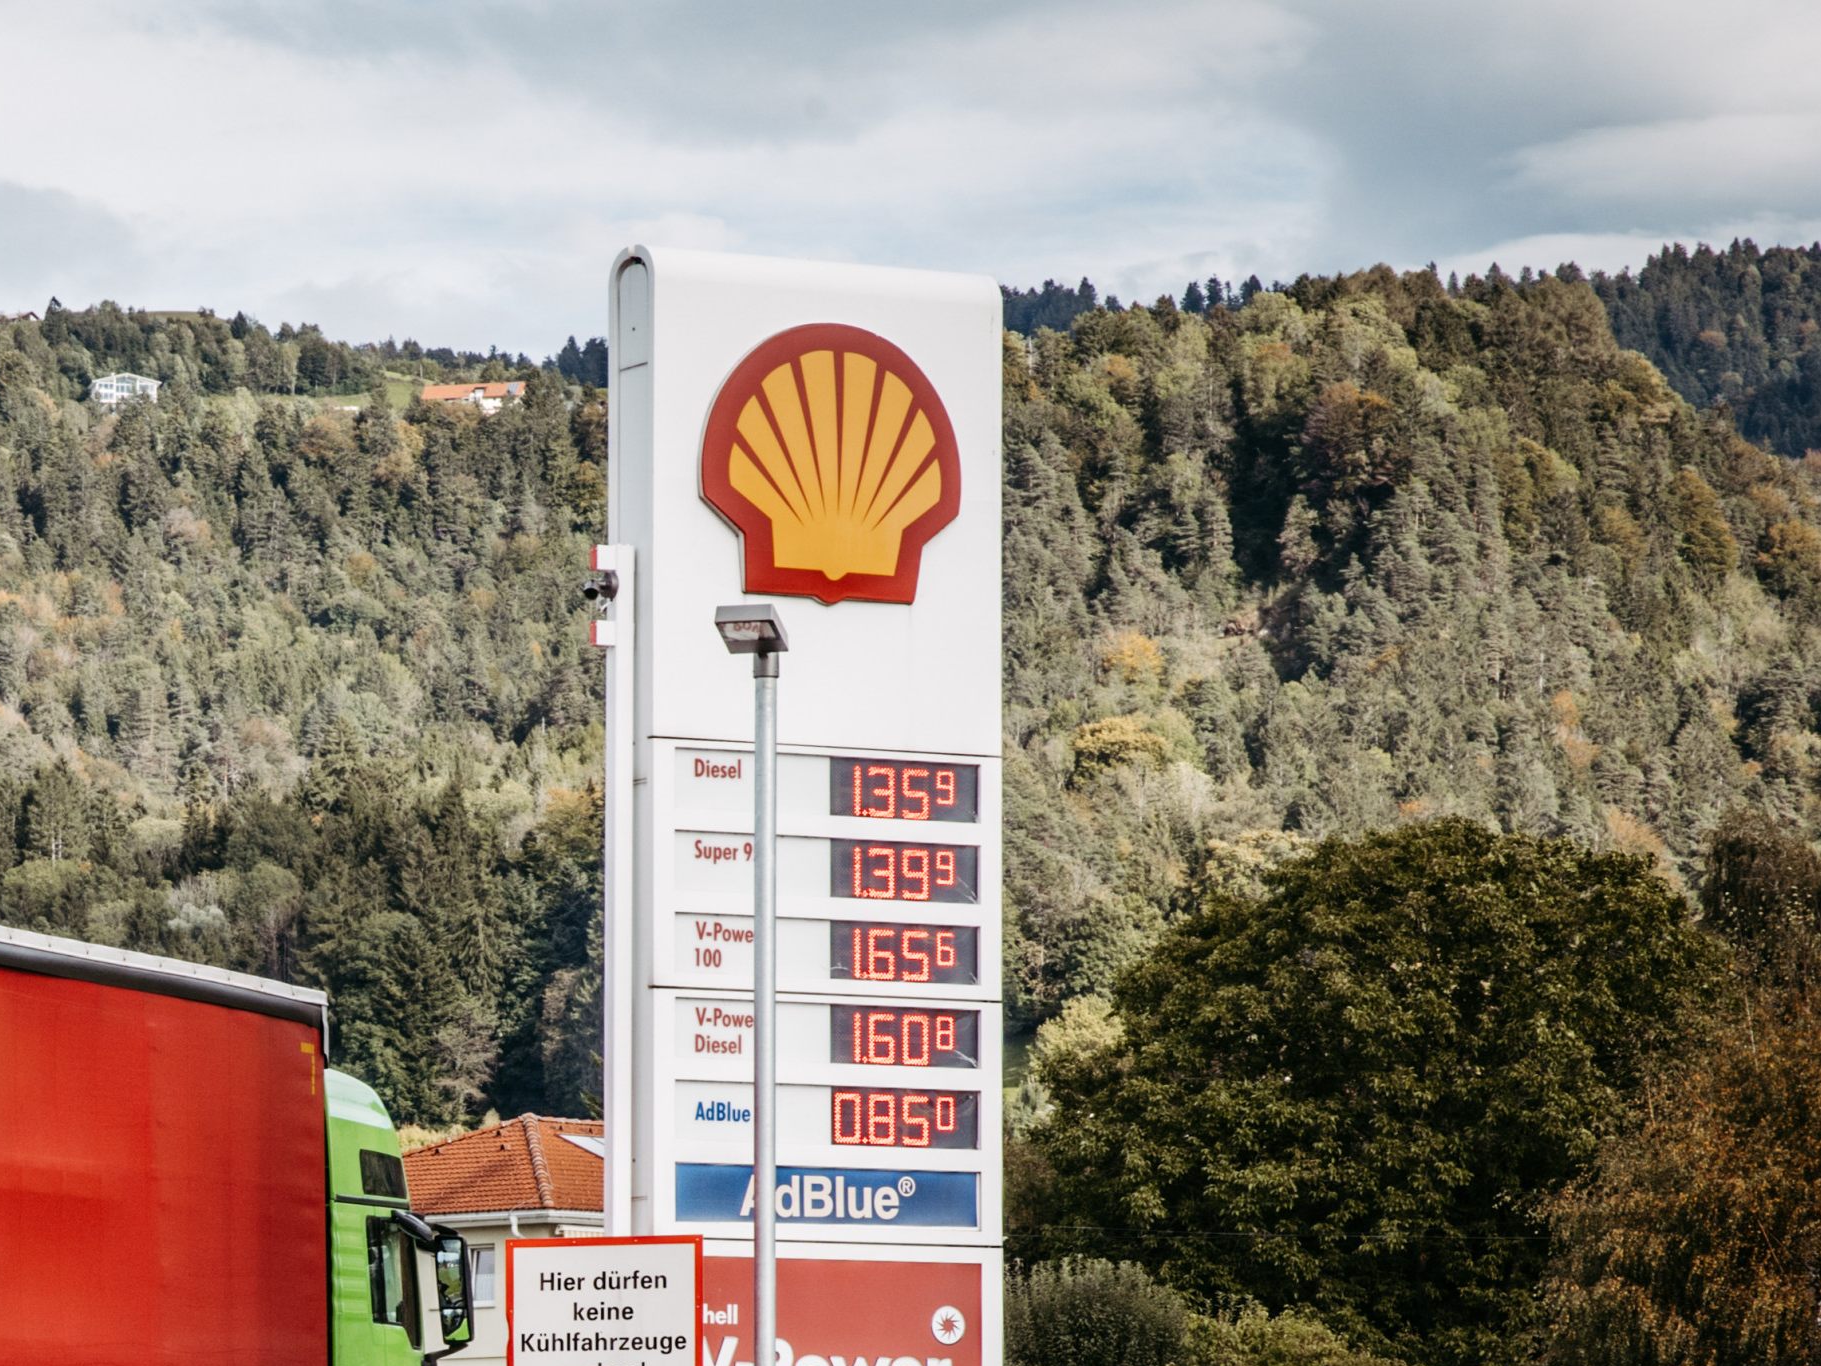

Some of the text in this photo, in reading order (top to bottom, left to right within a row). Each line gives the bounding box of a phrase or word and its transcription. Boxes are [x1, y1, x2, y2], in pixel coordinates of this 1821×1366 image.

[694, 758, 742, 779] Diesel
[694, 840, 754, 864] Super 9
[695, 921, 754, 943] V-Powe
[694, 948, 722, 968] 100
[695, 1007, 754, 1028] V-Powe
[694, 1034, 742, 1054] Diesel
[695, 1101, 751, 1122] AdBlue
[833, 1091, 956, 1146] 0.850
[540, 1270, 667, 1291] Hier dürfen
[573, 1302, 634, 1321] keine
[703, 1303, 738, 1325] hell
[521, 1332, 687, 1355] Kühlfahrzeuge
